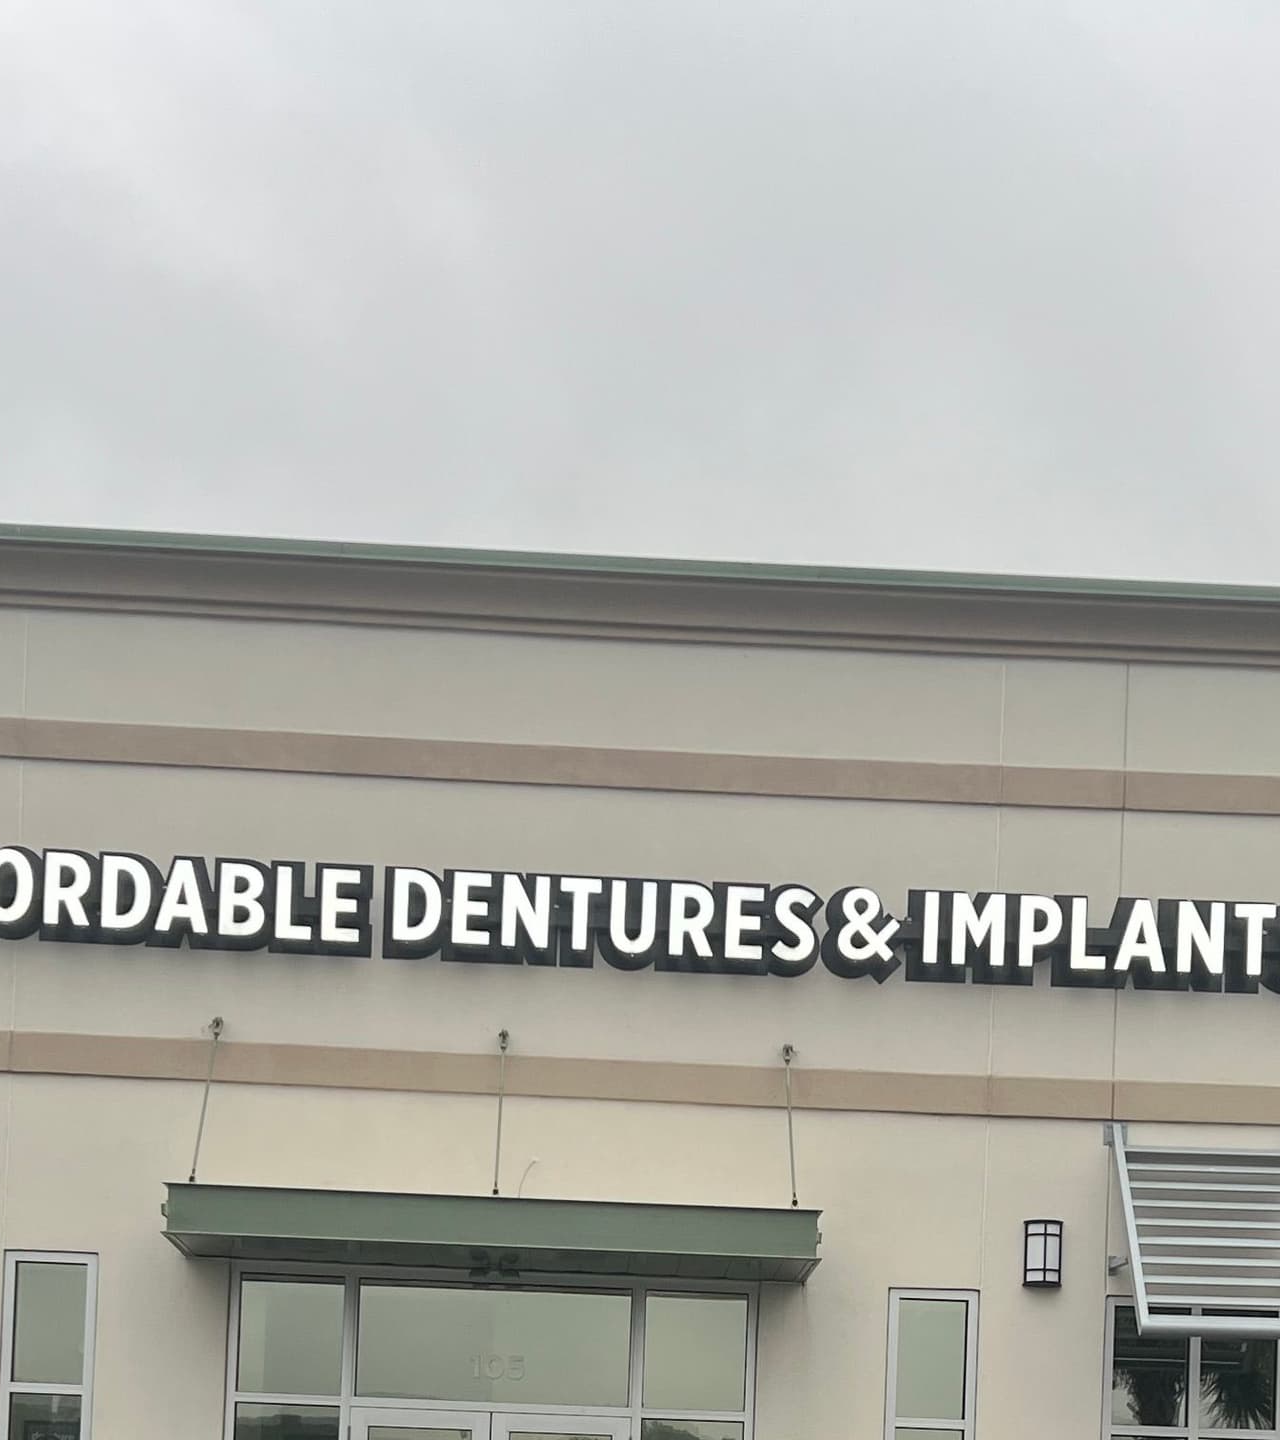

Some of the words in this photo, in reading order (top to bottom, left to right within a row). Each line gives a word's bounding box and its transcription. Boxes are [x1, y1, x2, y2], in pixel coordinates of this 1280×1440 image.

[392, 868, 815, 961] DENTURES
[837, 888, 901, 962] &
[471, 1354, 525, 1381] 105
